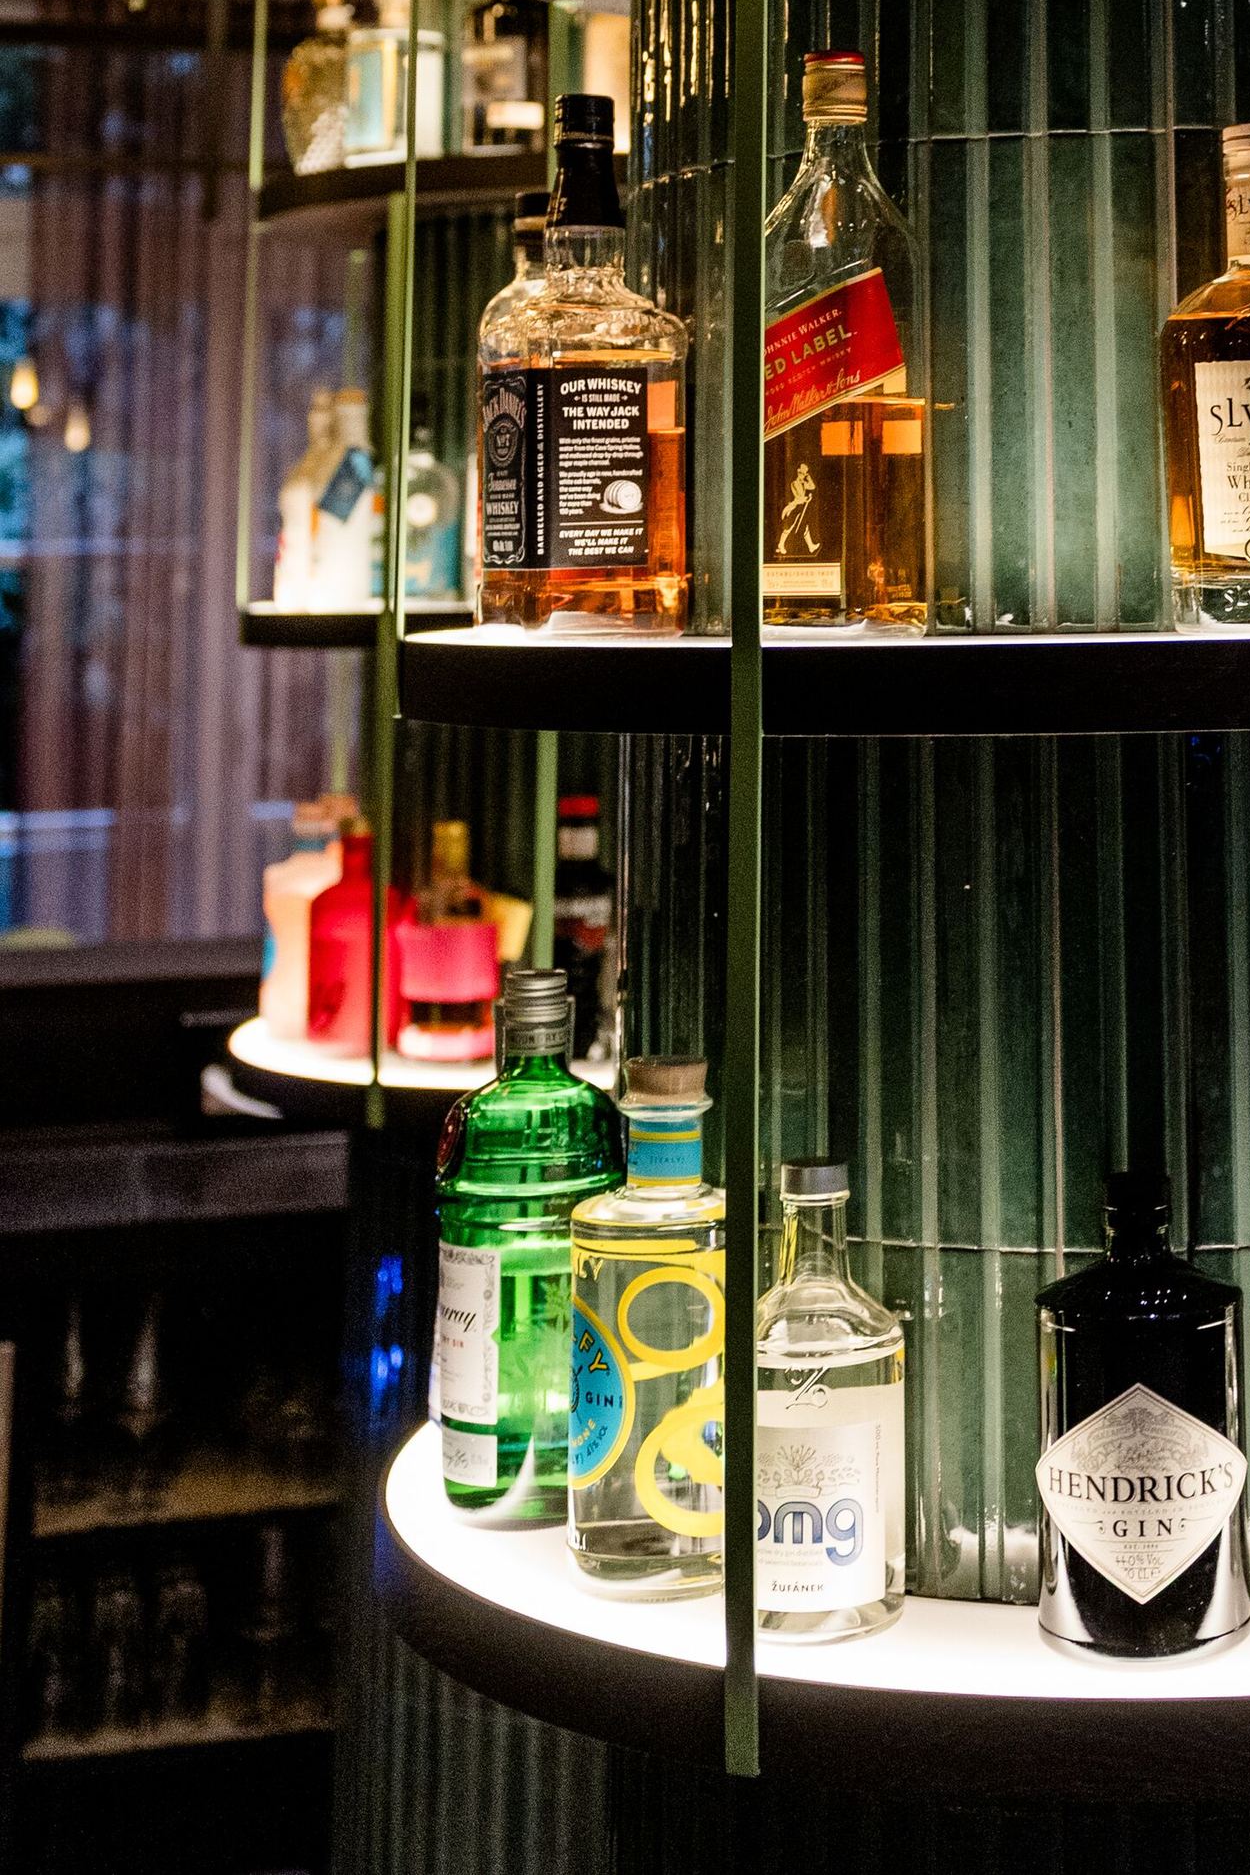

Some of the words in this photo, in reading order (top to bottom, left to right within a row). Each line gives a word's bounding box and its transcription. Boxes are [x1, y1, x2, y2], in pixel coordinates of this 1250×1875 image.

[560, 379, 586, 395] OUR
[587, 378, 642, 394] WHISKEY
[581, 394, 588, 403] IS
[589, 394, 603, 403] STILL
[604, 393, 620, 403] MADE
[537, 383, 545, 440] DISTILLERY
[562, 406, 584, 418] THE
[586, 406, 610, 417] WAY
[610, 405, 640, 417] JACK
[573, 418, 629, 430] INTENDED
[537, 453, 545, 476] AGED
[537, 478, 545, 501] AND
[486, 501, 519, 516] WHISKEY
[537, 503, 545, 555] BARRELED
[559, 530, 584, 538] EVERY
[584, 529, 600, 537] DAY
[613, 528, 635, 536] MAKE
[574, 538, 596, 546] WE'LL
[597, 537, 620, 545] MAKE
[568, 548, 583, 556] THE
[584, 547, 605, 555] BEST
[604, 546, 617, 554] WE
[617, 546, 635, 554] CAN
[586, 1392, 613, 1407] GIN
[1049, 1462, 1233, 1503] HENDRICK'S
[1112, 1518, 1173, 1538] GIN
[771, 1579, 824, 1593] ŽUFÁNEK
